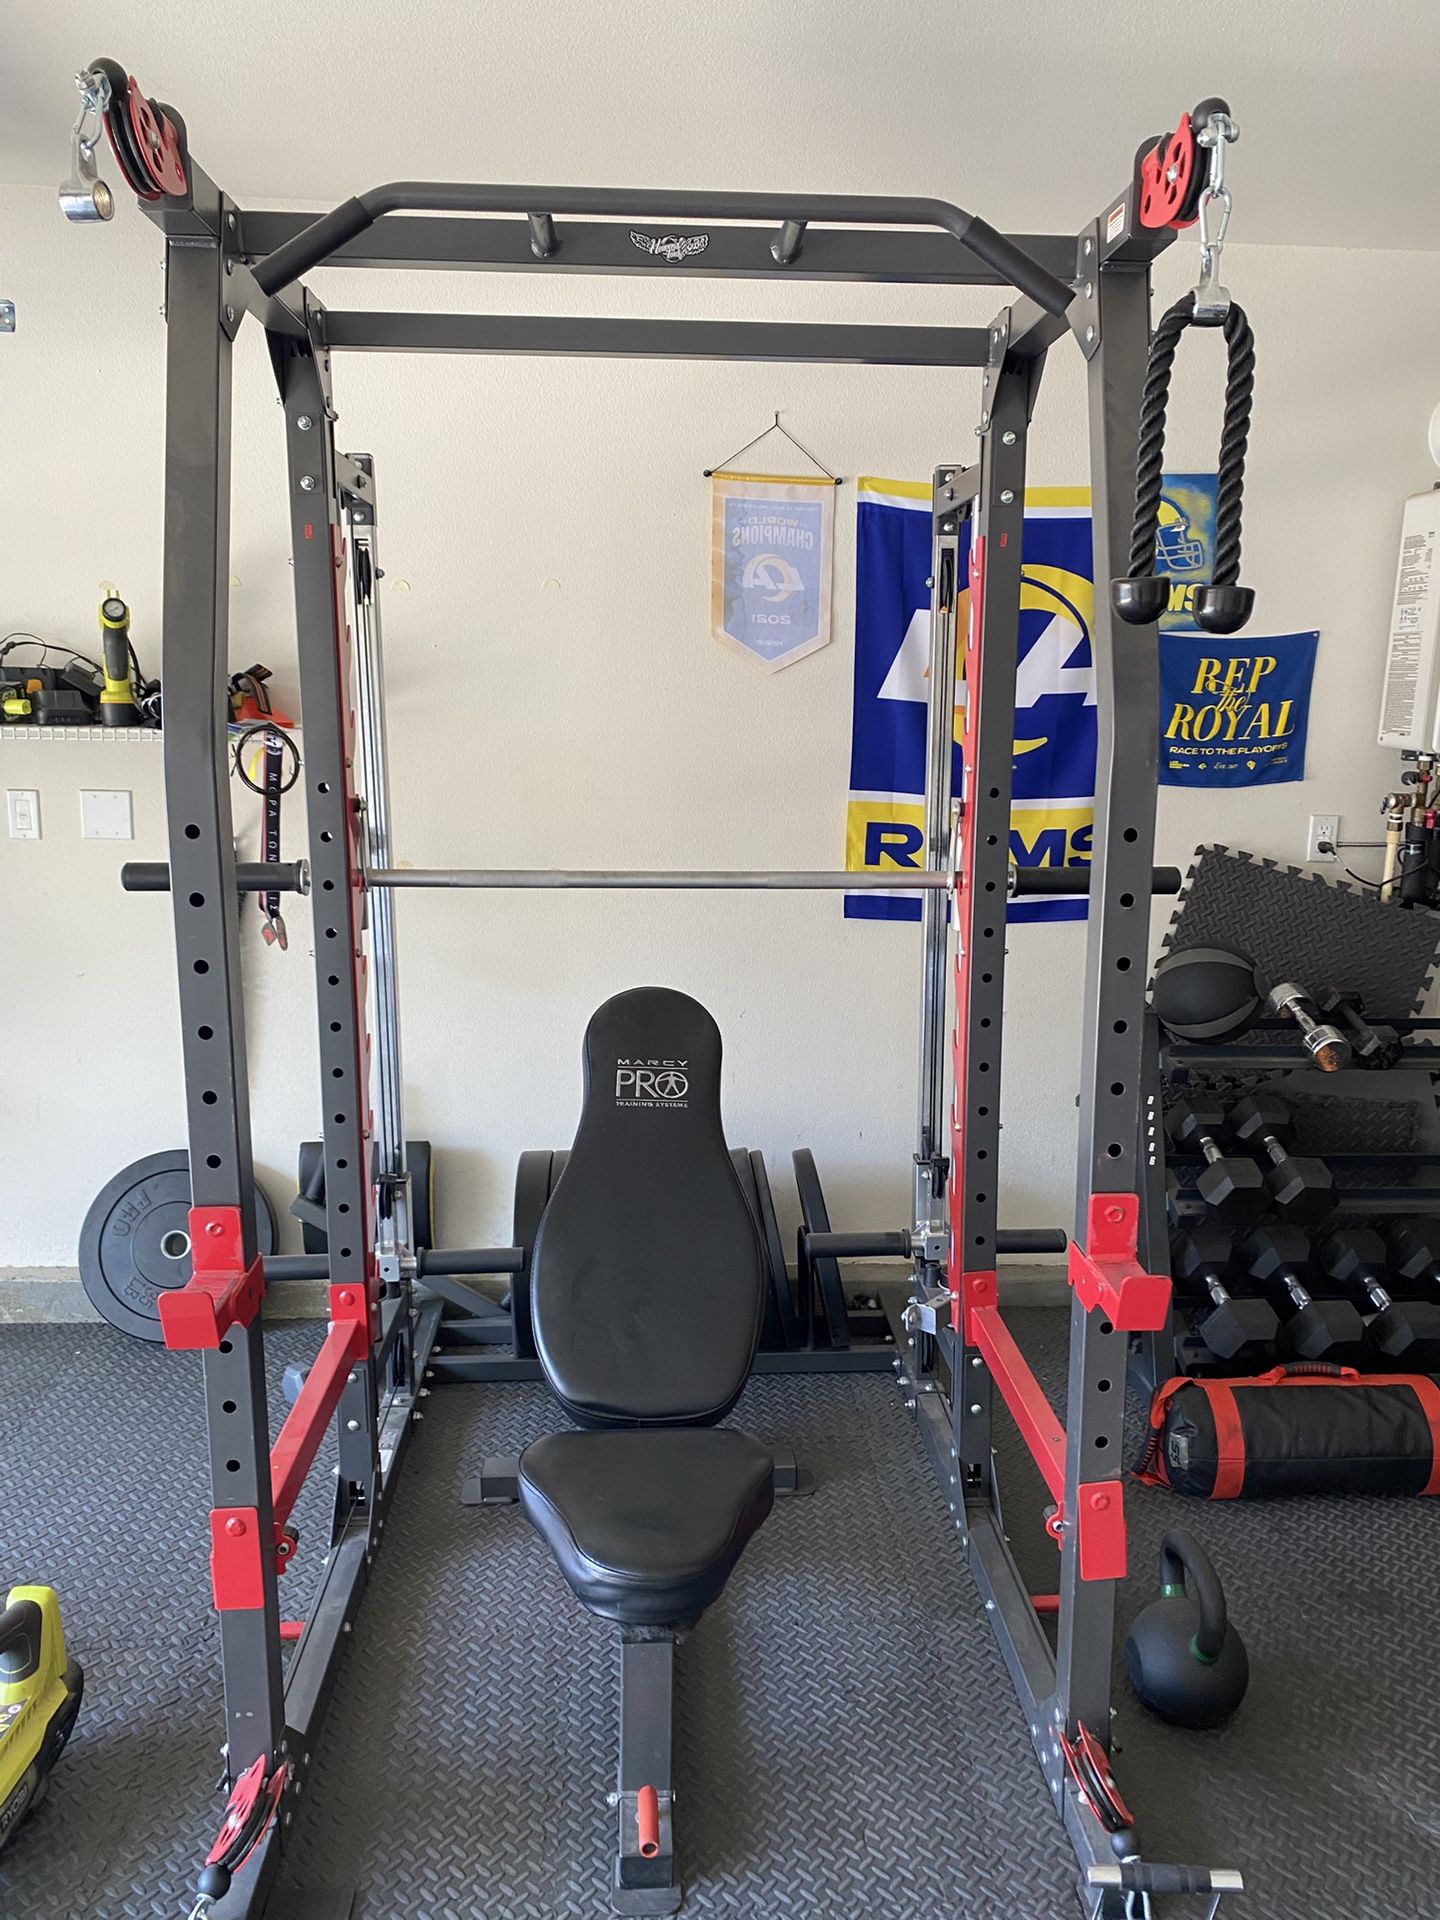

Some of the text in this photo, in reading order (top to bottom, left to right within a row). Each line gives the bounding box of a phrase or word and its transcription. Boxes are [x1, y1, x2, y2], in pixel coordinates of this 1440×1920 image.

[1191, 656, 1277, 694] REP
[1163, 700, 1295, 742] ROYAL
[1169, 746, 1199, 755] RACE
[1201, 747, 1215, 756] TO
[1216, 747, 1237, 755] THE
[617, 1058, 688, 1067] MARCY
[615, 1069, 689, 1099] PRO
[1, 1784, 29, 1829] RYOBI
